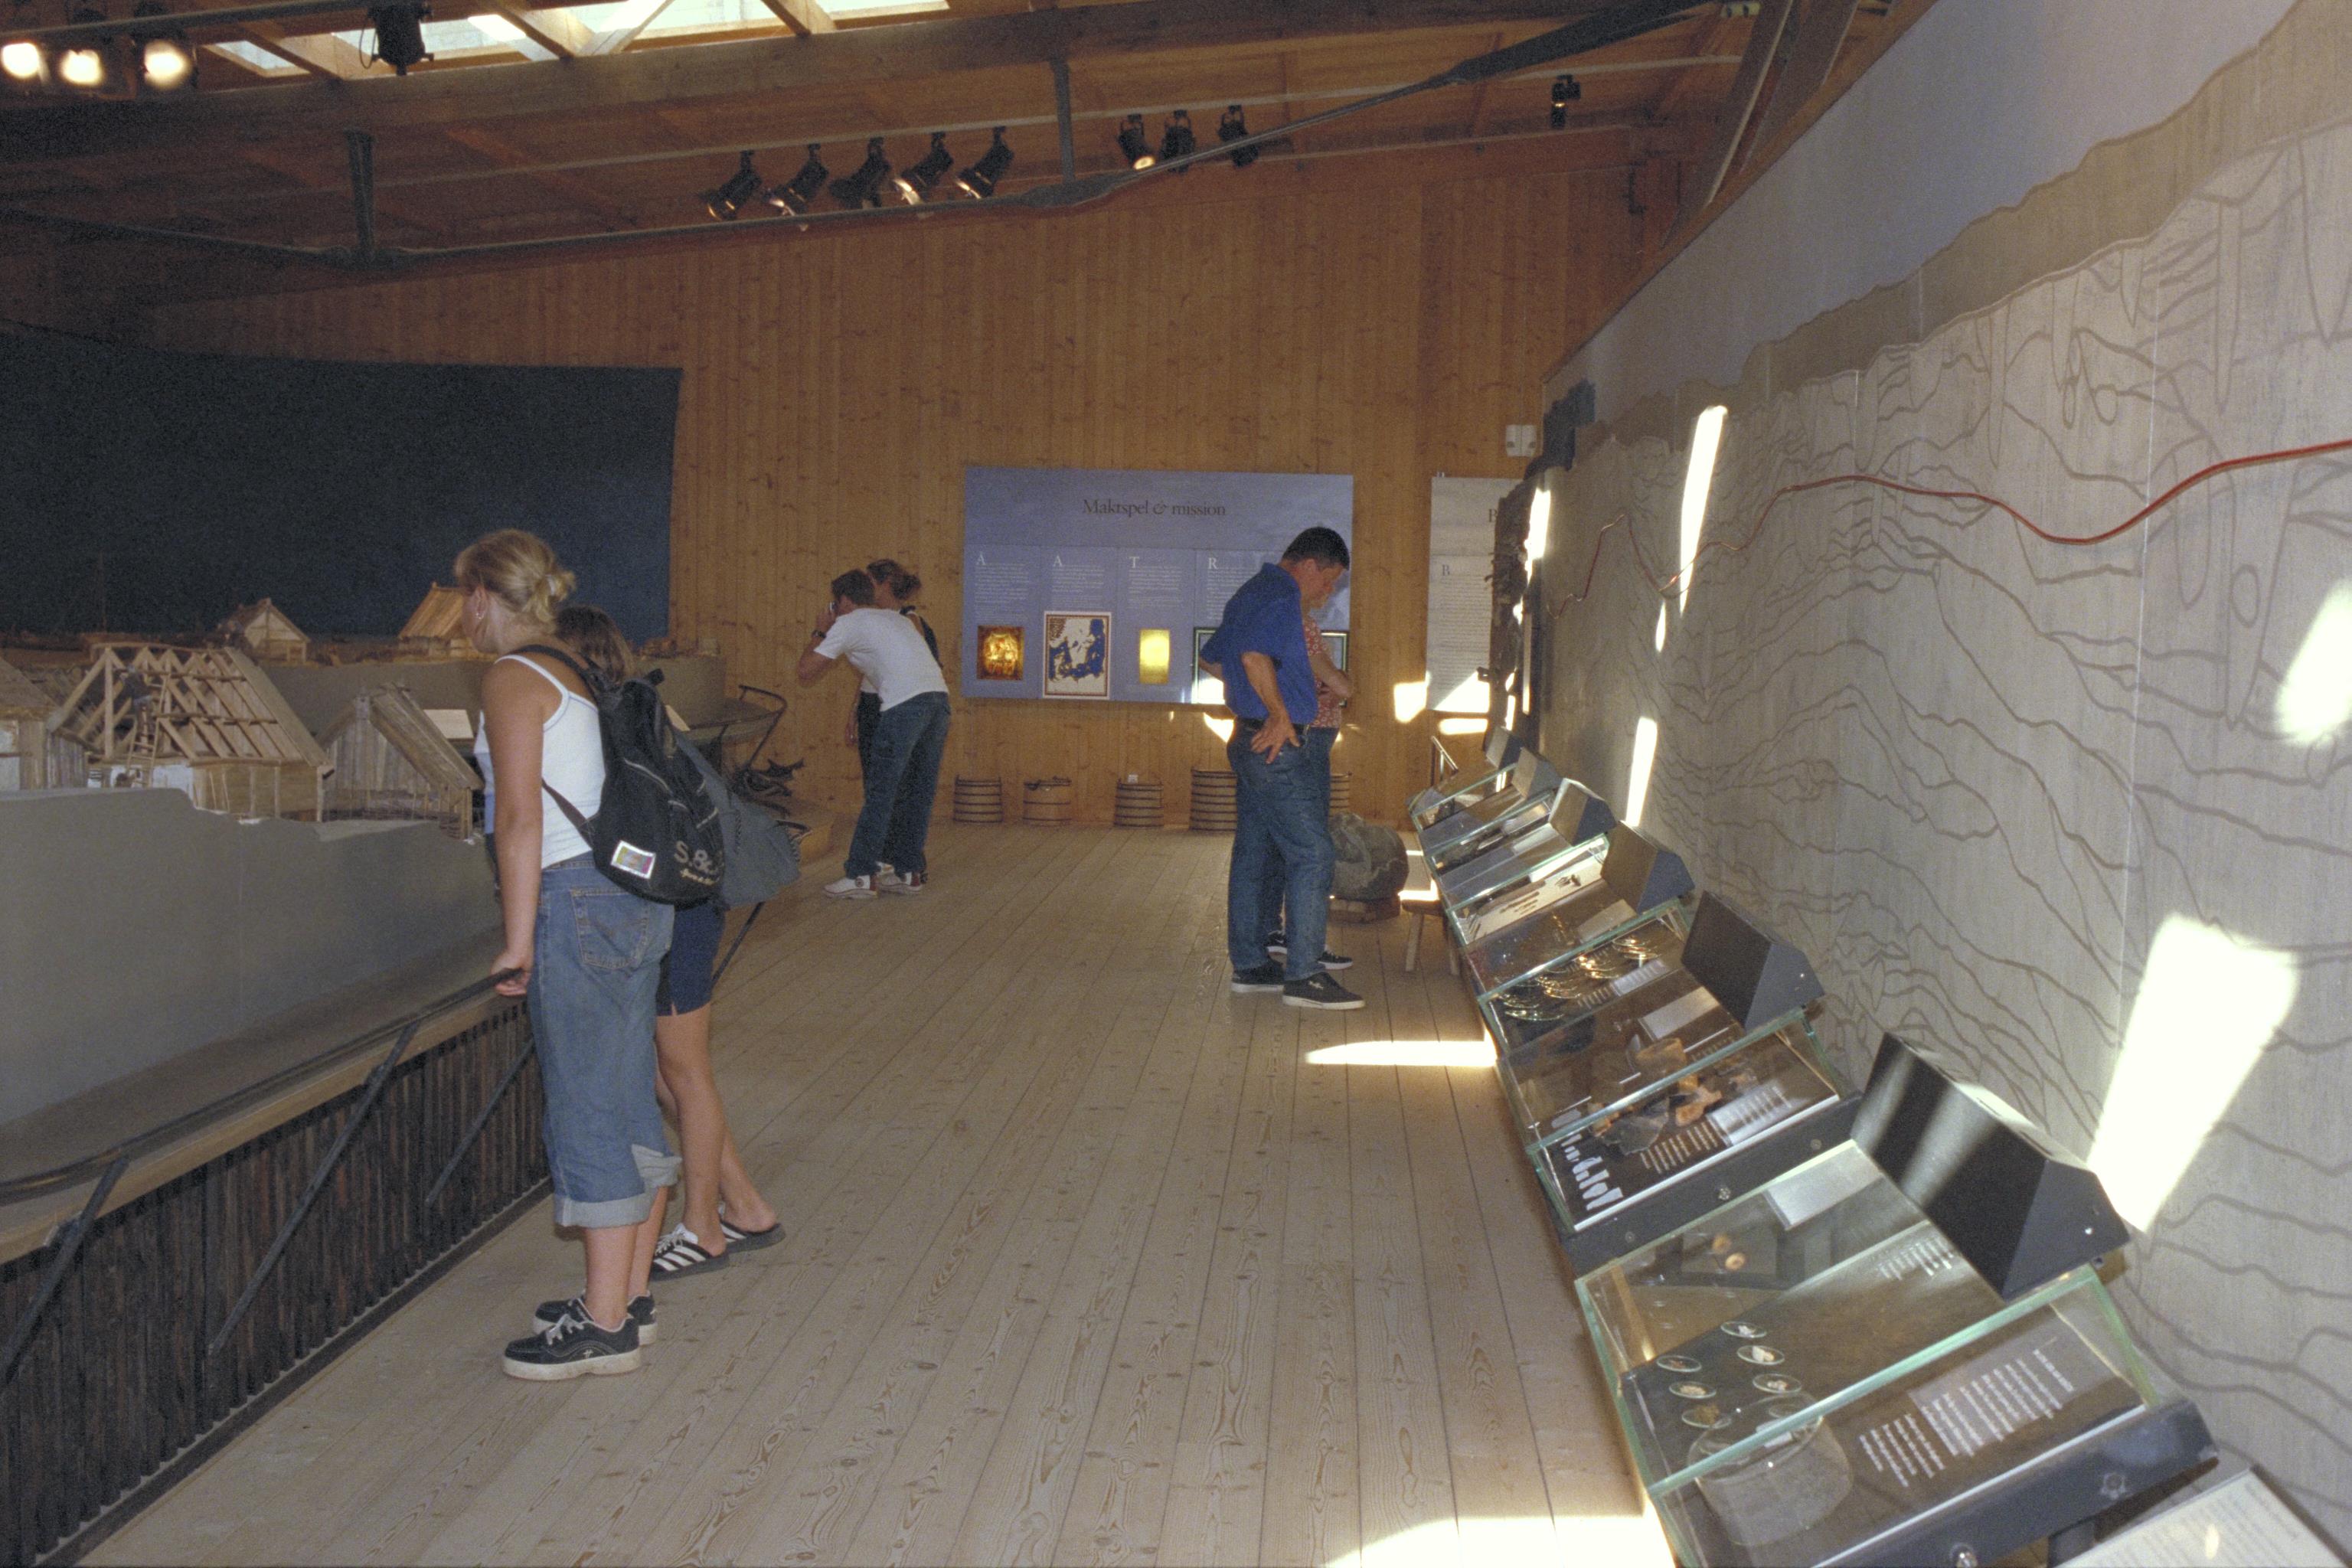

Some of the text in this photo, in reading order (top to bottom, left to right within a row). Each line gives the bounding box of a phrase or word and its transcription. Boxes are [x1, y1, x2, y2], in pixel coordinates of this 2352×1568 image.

[1082, 499, 1226, 518] Maktspel & mission
[1129, 556, 1140, 569] T
[1208, 557, 1219, 570] R
